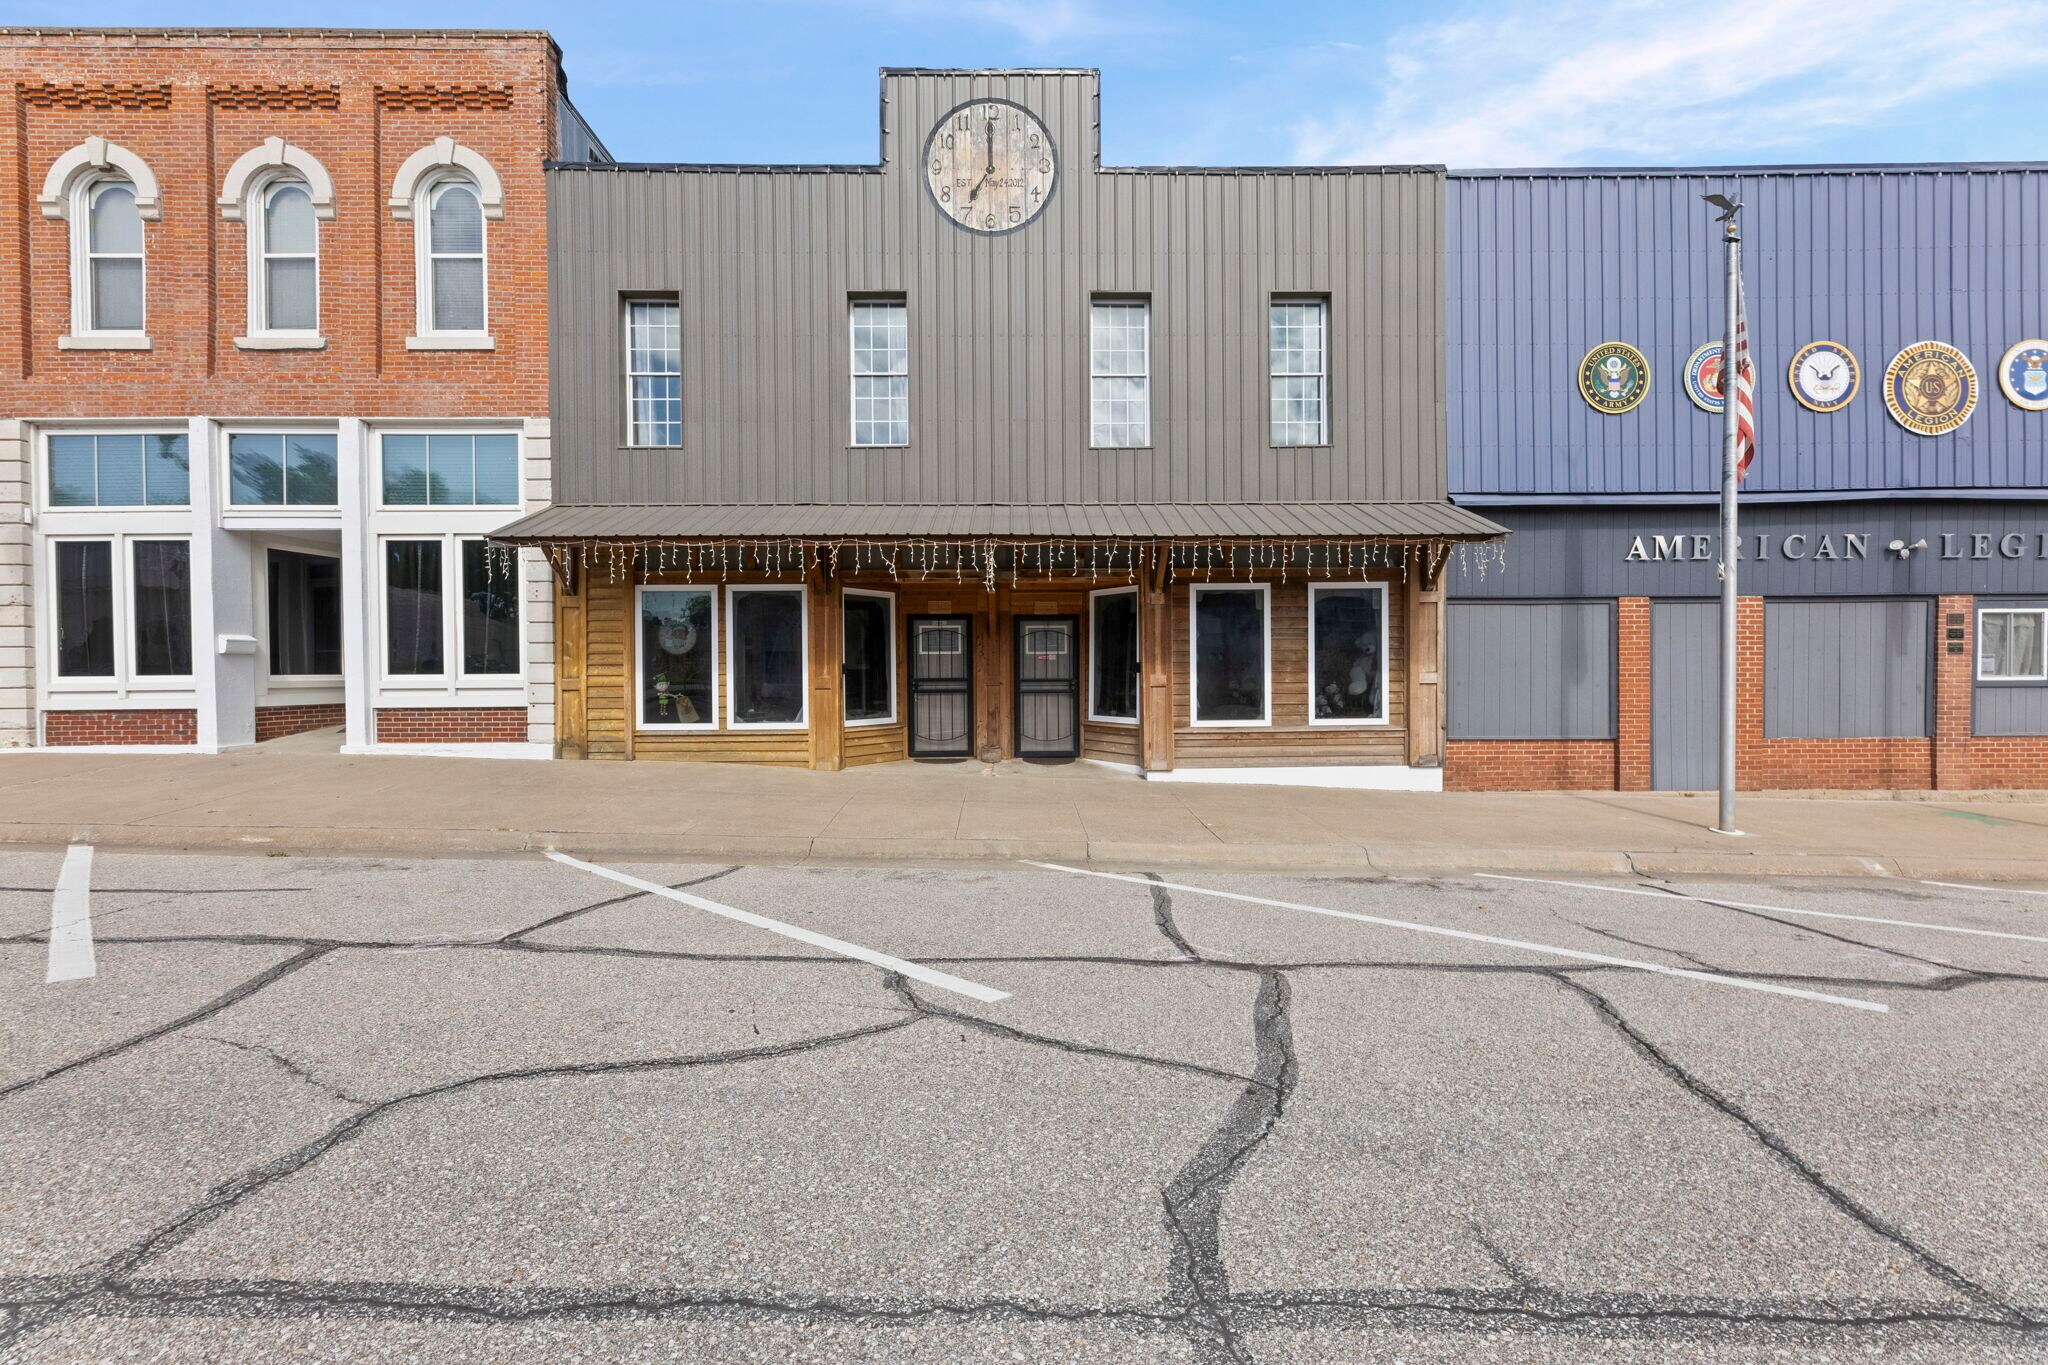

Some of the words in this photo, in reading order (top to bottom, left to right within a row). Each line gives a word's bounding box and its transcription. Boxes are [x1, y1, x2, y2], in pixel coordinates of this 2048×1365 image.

[981, 105, 1000, 121] 12
[957, 114, 970, 131] 11
[1012, 114, 1021, 131] 1
[940, 134, 954, 150] 10
[1029, 133, 1041, 149] 2
[931, 159, 942, 175] 9
[1038, 158, 1051, 174] 3
[940, 185, 951, 203] 8
[1030, 185, 1042, 203] 4
[960, 206, 973, 221] 7
[985, 213, 996, 229] 6
[1009, 206, 1022, 223] 5
[1588, 347, 1615, 367] UNITED
[1616, 347, 1641, 367] STATES
[1692, 348, 1722, 376] DEPARTMENT
[1793, 348, 1817, 382] UNITED
[1833, 348, 1855, 382] STATES
[1898, 351, 1966, 378] AMERICAN
[1925, 381, 1941, 394] US
[1603, 400, 1628, 408] ARMY
[1906, 409, 1958, 425] LEGION
